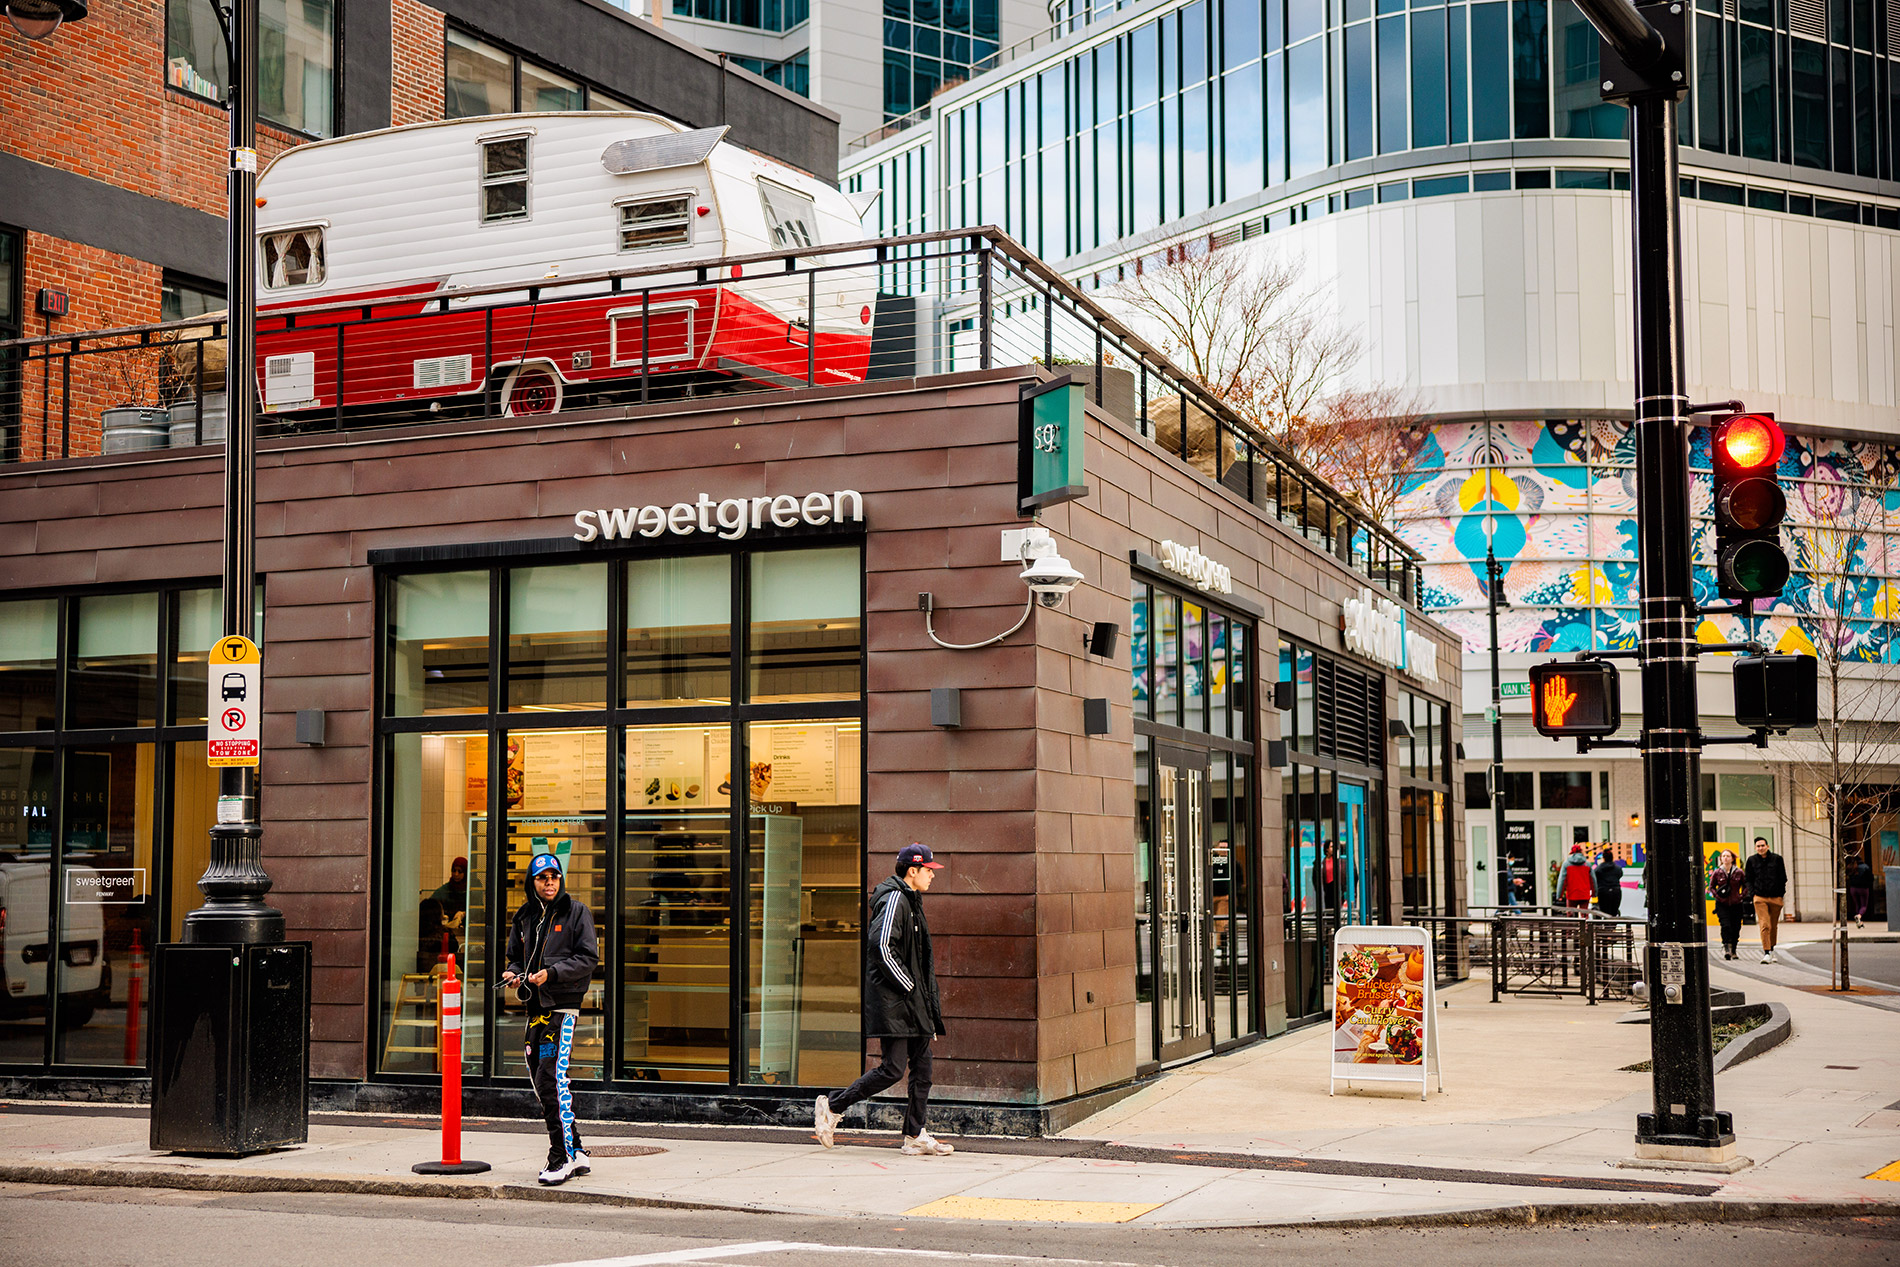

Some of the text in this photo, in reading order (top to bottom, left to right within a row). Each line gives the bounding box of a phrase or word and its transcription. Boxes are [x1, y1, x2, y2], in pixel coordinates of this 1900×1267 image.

[48, 292, 66, 313] EXIT
[573, 489, 864, 543] sweetgreen
[227, 644, 242, 657] T
[1503, 684, 1518, 694] VAN
[769, 804, 783, 814] Up
[521, 819, 556, 827] DELIVERY
[568, 818, 585, 826] HERE
[76, 875, 135, 888] sweetgreen
[1357, 989, 1400, 999] Brussels
[1363, 1004, 1402, 1018] Curry
[1349, 1014, 1409, 1025] Cauliflower
